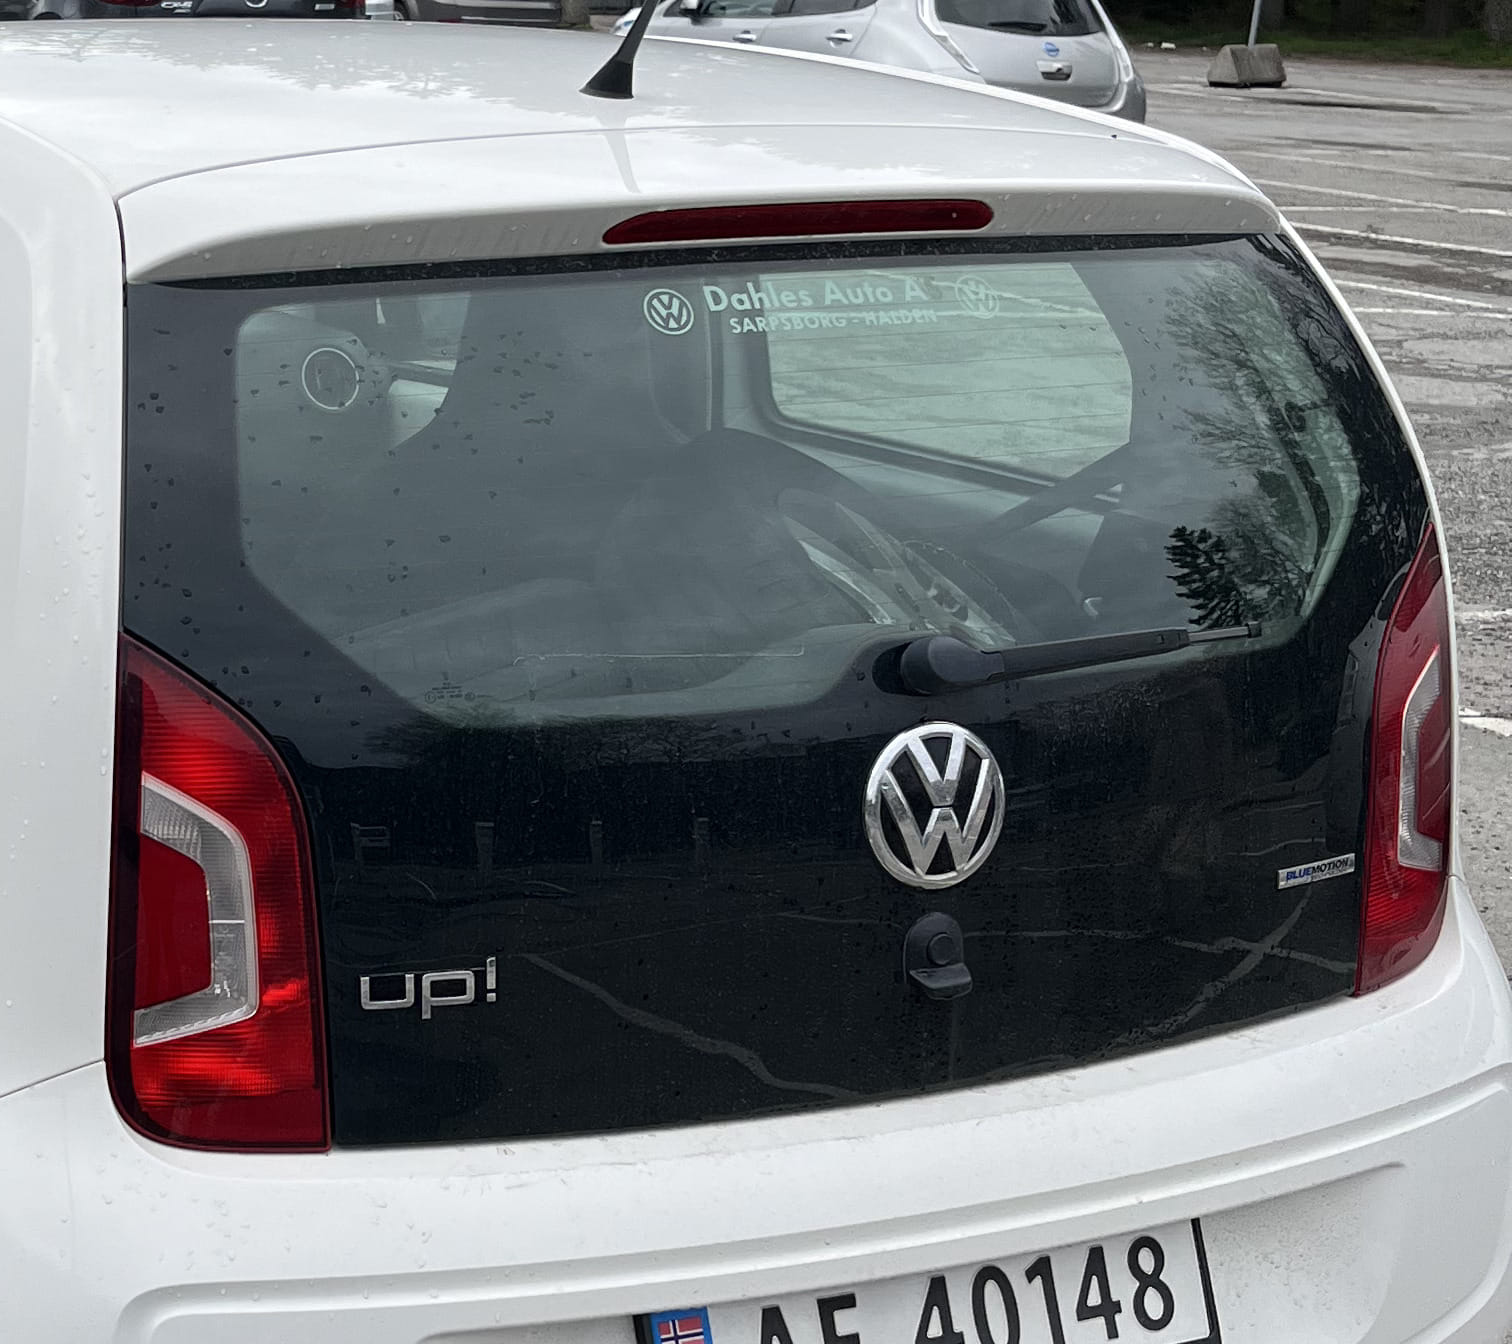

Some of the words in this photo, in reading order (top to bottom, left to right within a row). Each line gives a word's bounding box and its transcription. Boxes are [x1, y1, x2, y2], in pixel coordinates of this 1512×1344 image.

[702, 281, 814, 312] Dahles
[824, 279, 893, 305] Auto
[729, 313, 847, 334] SARPSBORG
[864, 308, 938, 326] HALDEN
[1286, 858, 1349, 881] BLUEMOTION
[360, 957, 496, 1020] up!
